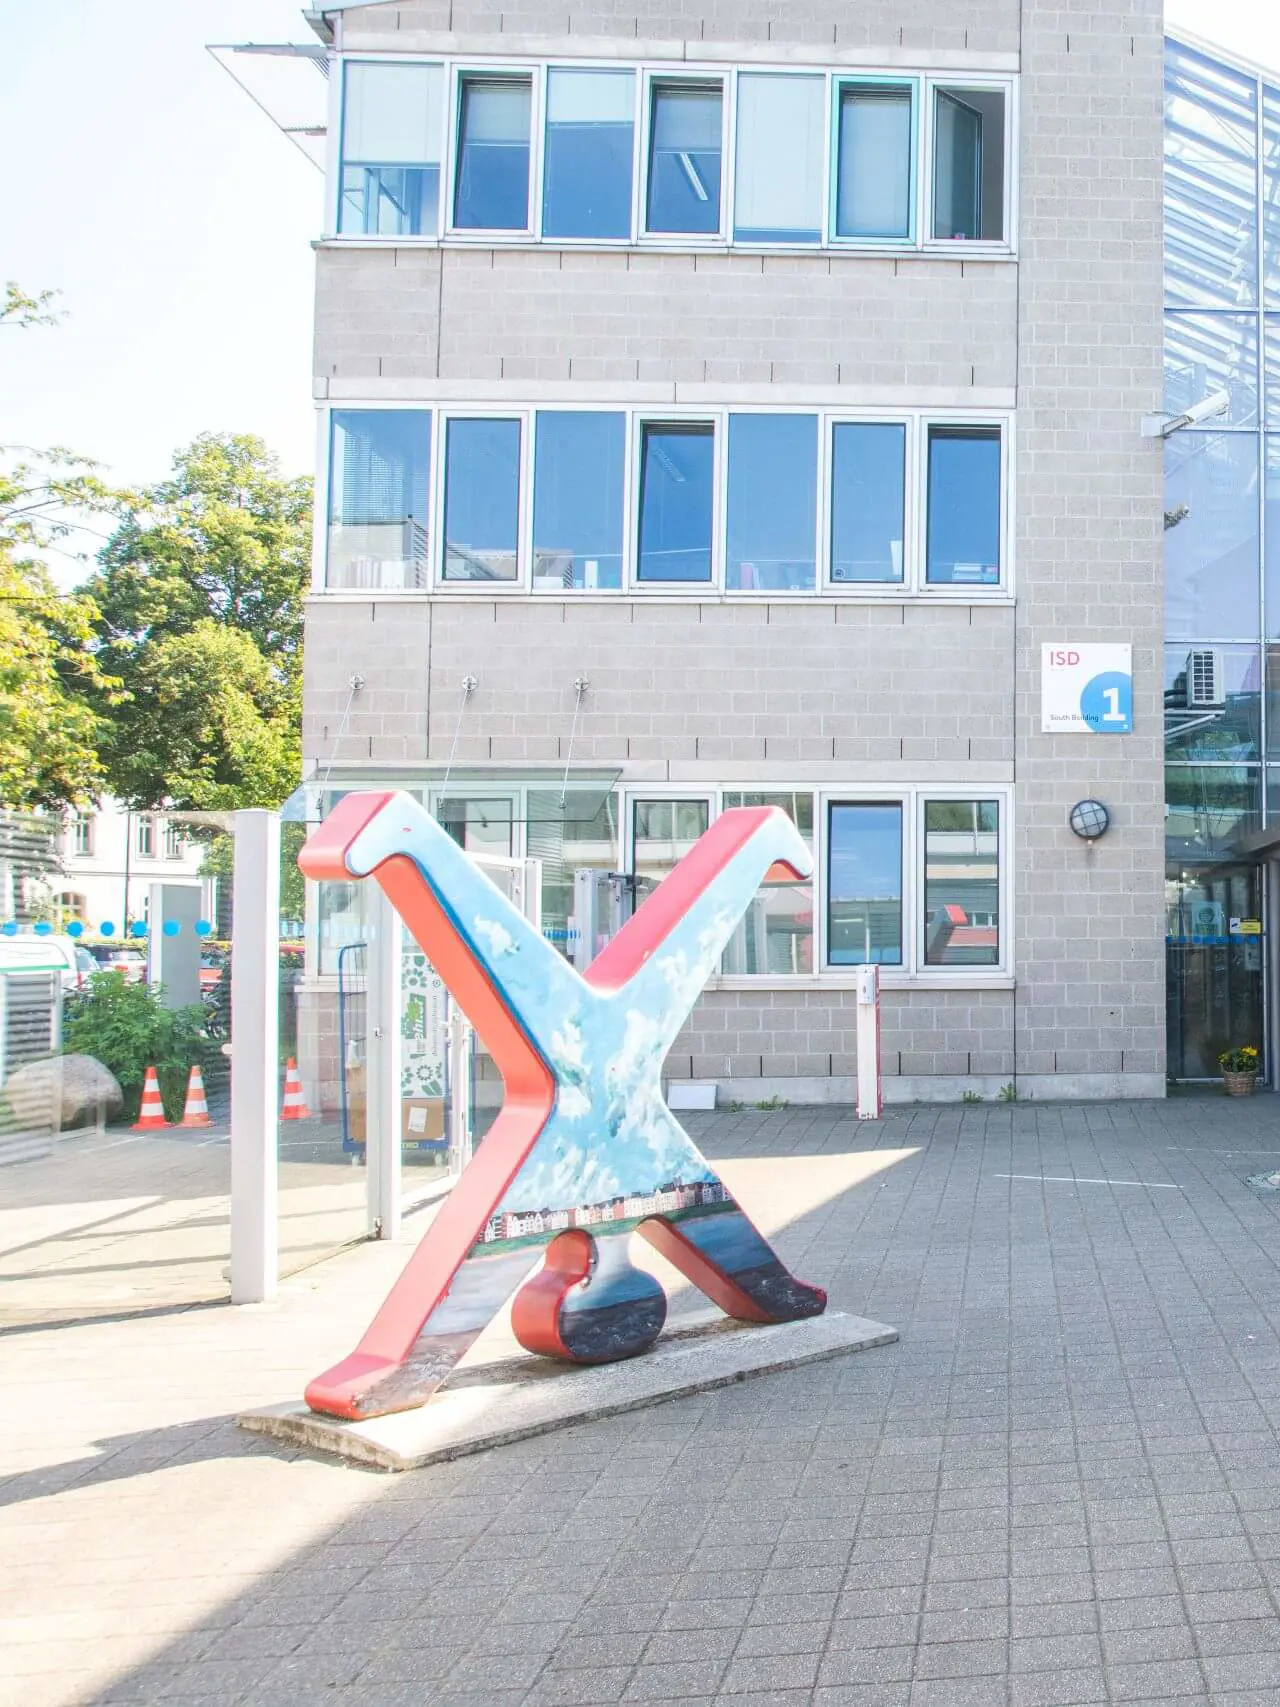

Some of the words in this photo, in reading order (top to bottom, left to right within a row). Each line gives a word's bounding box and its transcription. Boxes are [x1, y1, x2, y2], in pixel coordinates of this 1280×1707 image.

[1050, 651, 1080, 666] ISD
[1103, 687, 1126, 721] 1
[1050, 713, 1071, 721] South
[1071, 713, 1099, 722] Building
